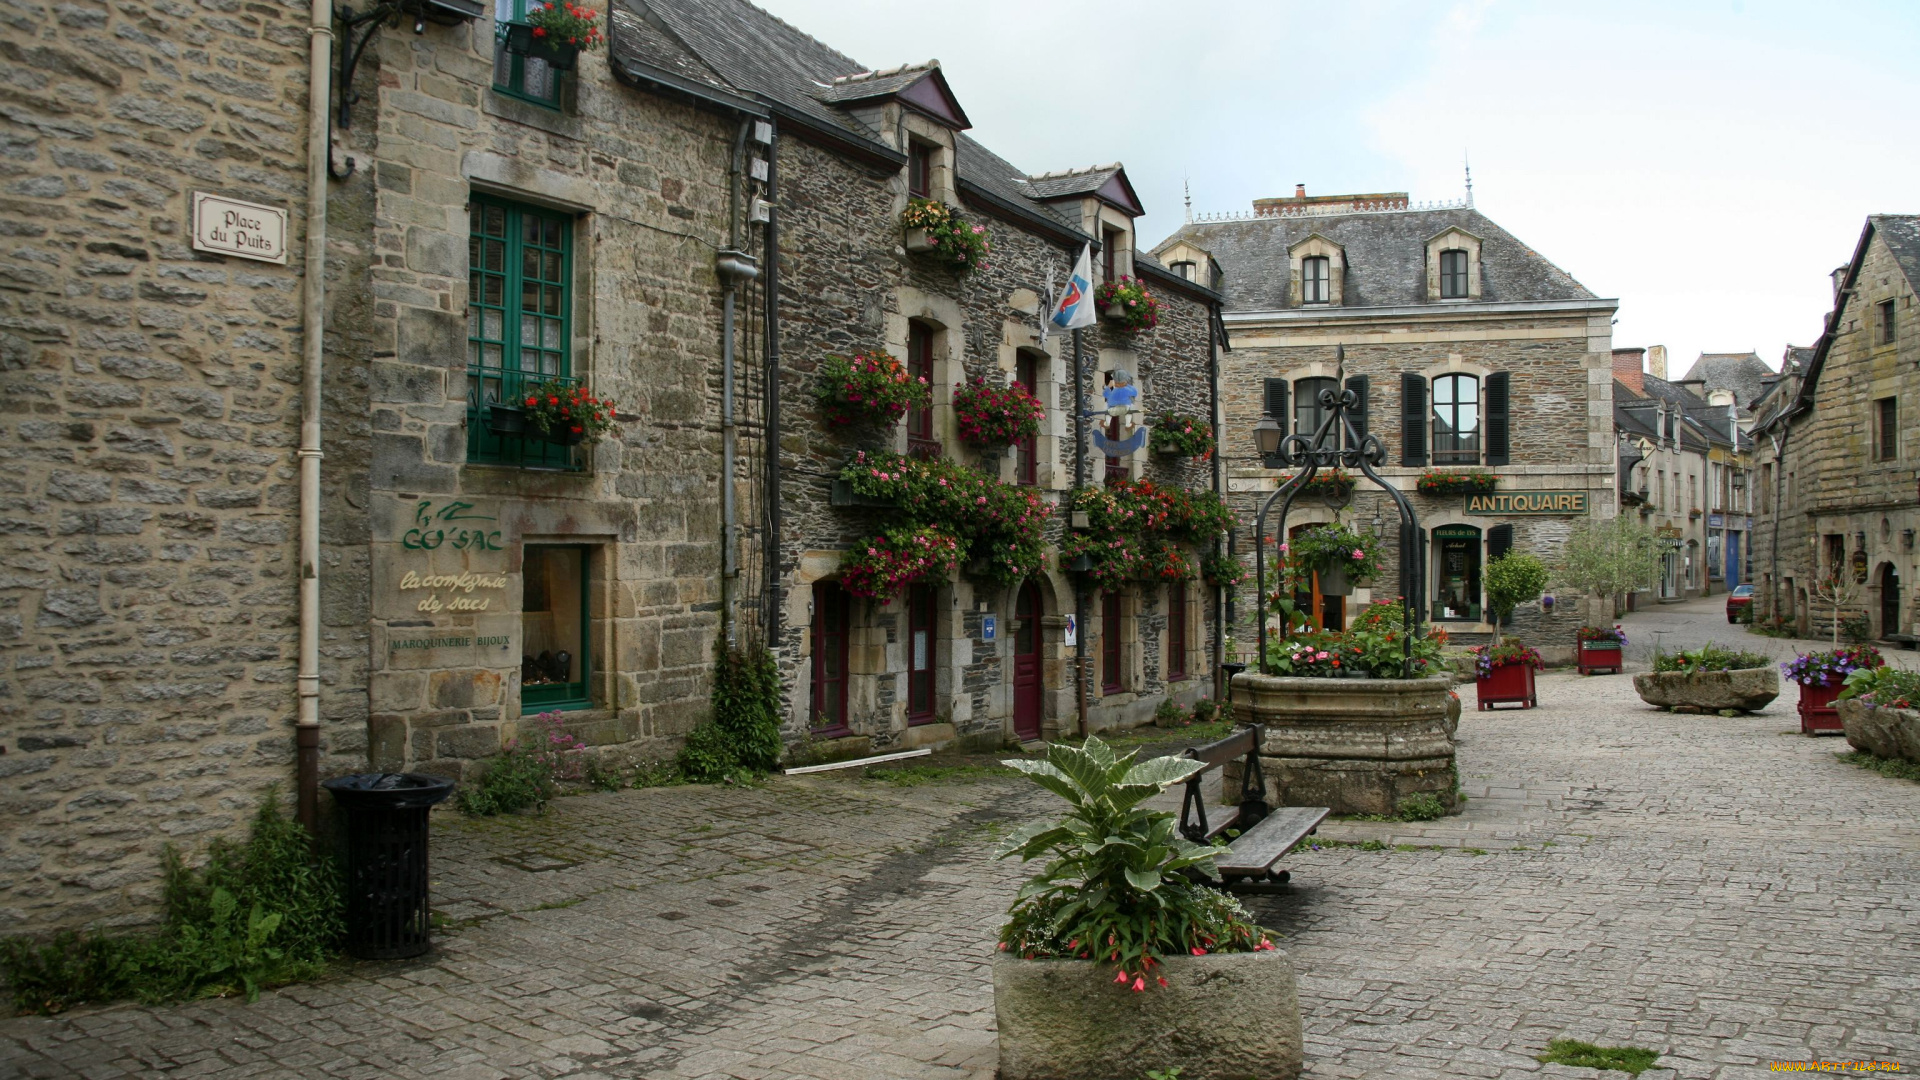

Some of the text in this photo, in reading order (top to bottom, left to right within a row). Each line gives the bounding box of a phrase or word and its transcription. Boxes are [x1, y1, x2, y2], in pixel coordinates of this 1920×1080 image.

[222, 210, 261, 230] Place
[210, 226, 272, 250] du Puits
[1469, 494, 1584, 512] ANTIQUAIRE
[400, 570, 420, 589] la
[447, 597, 489, 610] sacs
[392, 635, 510, 650] MAROQUINERIE BIJOUX
